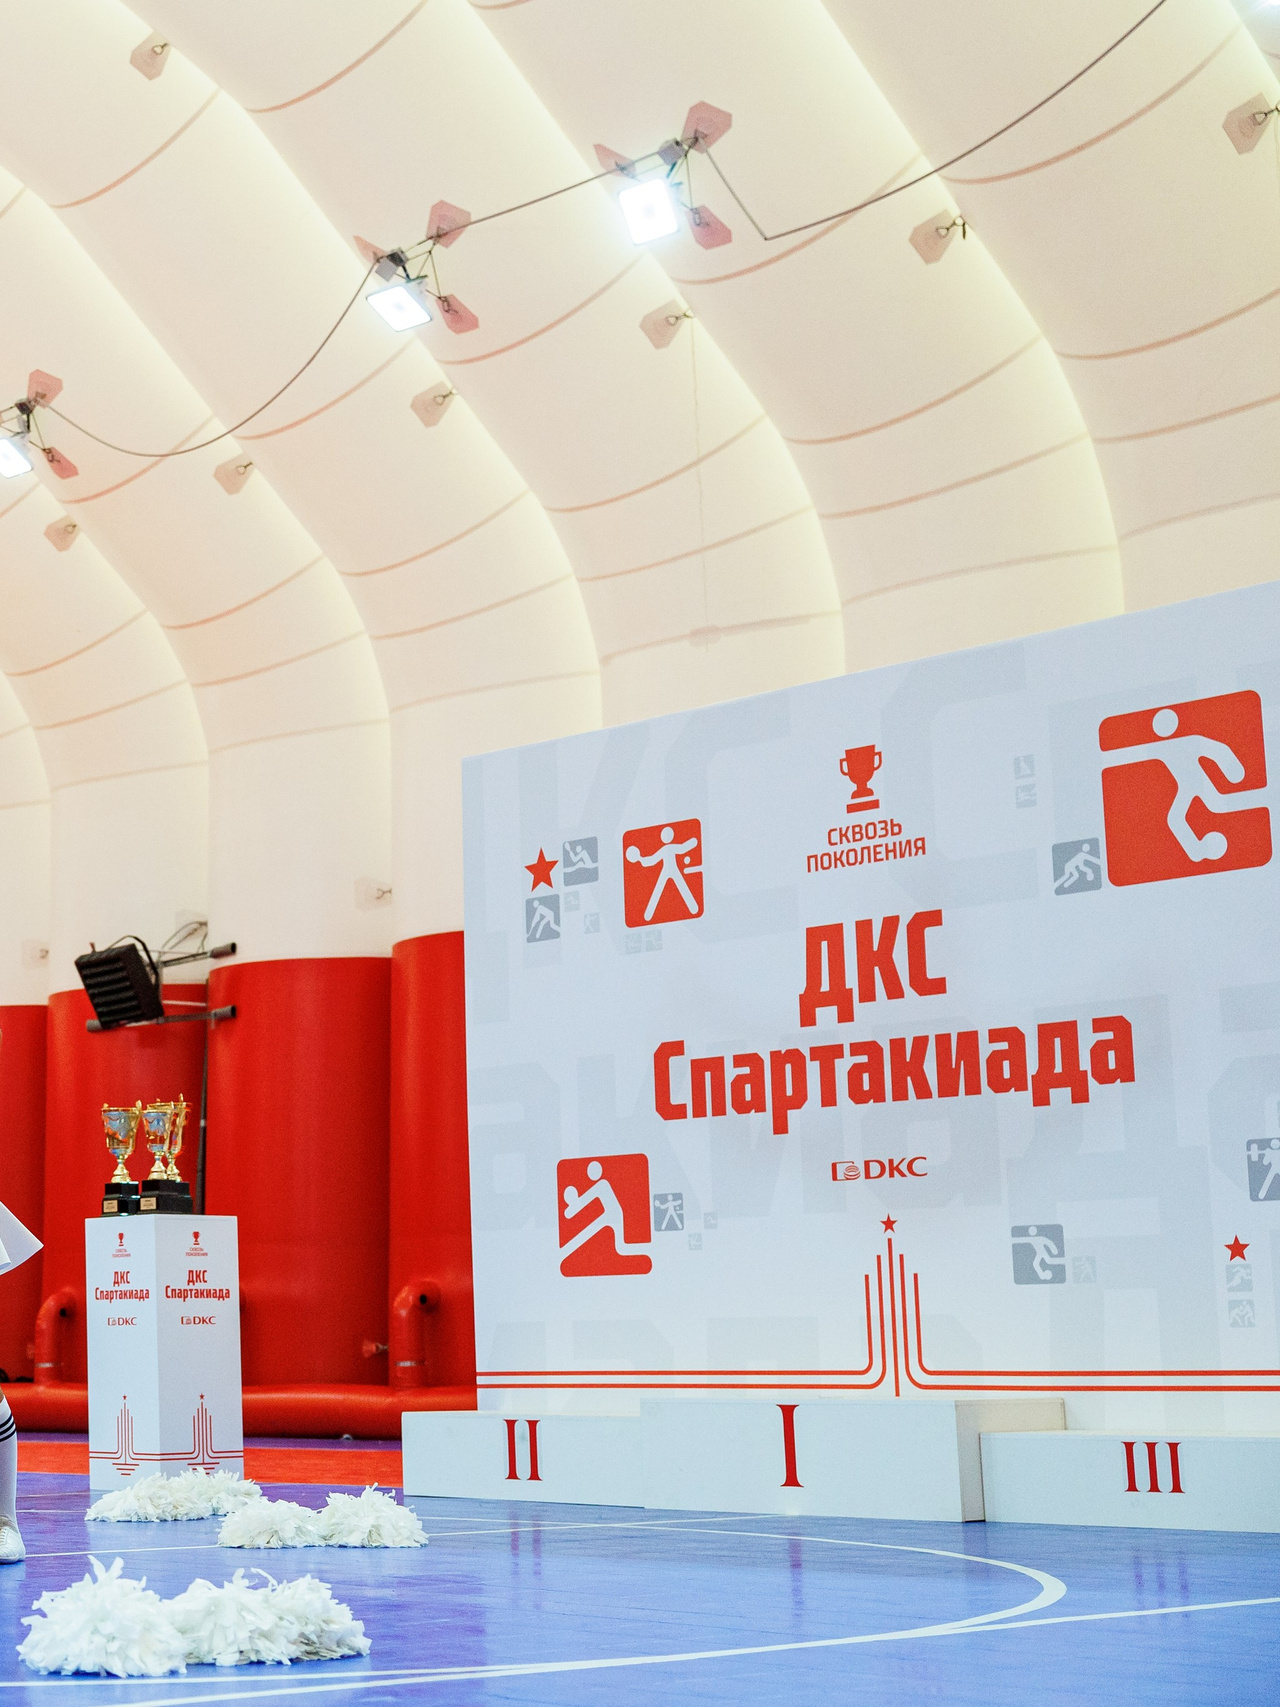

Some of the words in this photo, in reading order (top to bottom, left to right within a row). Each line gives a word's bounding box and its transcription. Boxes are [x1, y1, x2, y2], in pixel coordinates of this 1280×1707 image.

[827, 818, 903, 847] СКВОЗЬ
[806, 836, 927, 874] ПОКОЛЕНИЯ
[798, 908, 948, 1028] ДКС
[653, 1014, 1136, 1136] Спартакиада
[863, 1156, 928, 1180] DKC
[112, 1270, 131, 1288] ДКС
[187, 1269, 208, 1286] ДКС
[94, 1287, 150, 1303] Спартакиада
[164, 1284, 231, 1303] Спартакиада
[117, 1316, 137, 1326] DKC
[192, 1315, 217, 1325] DKC
[504, 1418, 542, 1481] II
[777, 1404, 804, 1487] I
[1123, 1441, 1184, 1494] III
